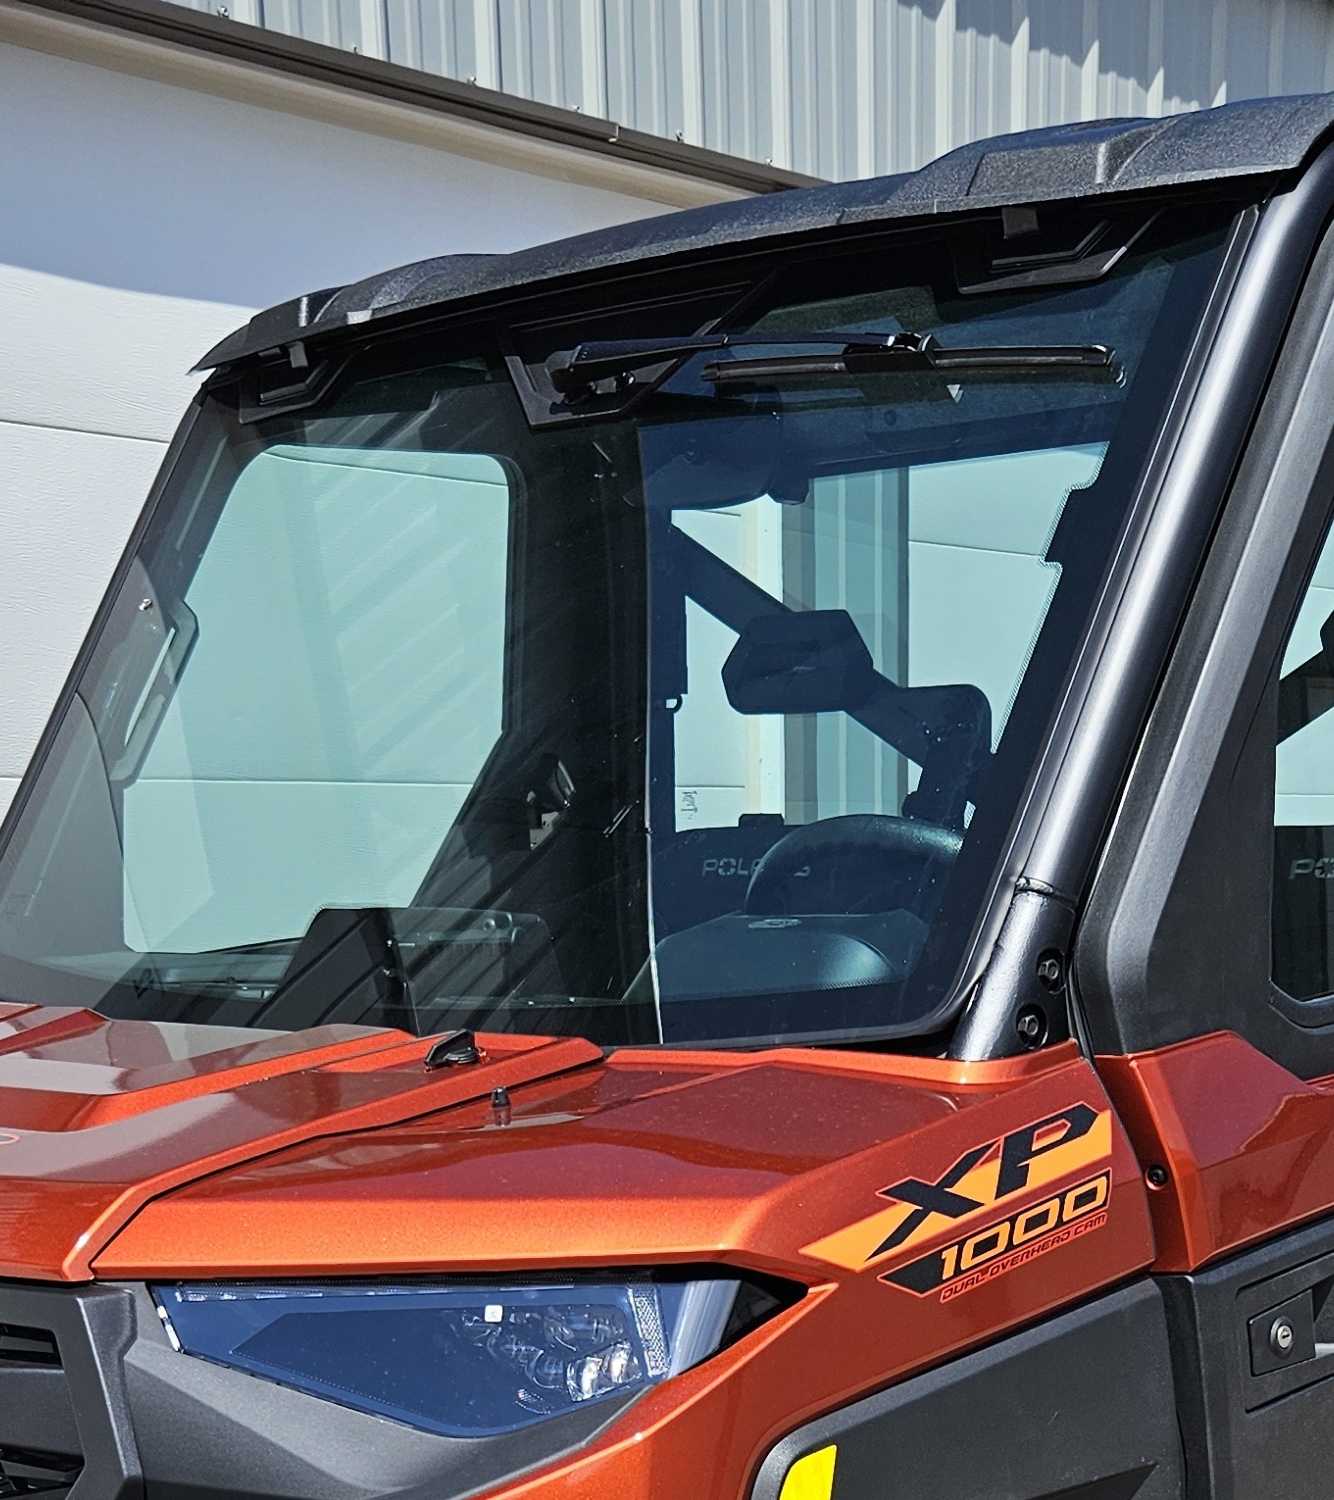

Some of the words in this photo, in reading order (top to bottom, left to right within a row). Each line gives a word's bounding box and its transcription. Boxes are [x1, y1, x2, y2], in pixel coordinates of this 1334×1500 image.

[863, 1102, 1099, 1263] XP
[940, 1175, 1108, 1281] 1000
[942, 1272, 985, 1301] DUAL
[991, 1232, 1070, 1276] OVERHEAD
[1073, 1213, 1107, 1237] CAM
